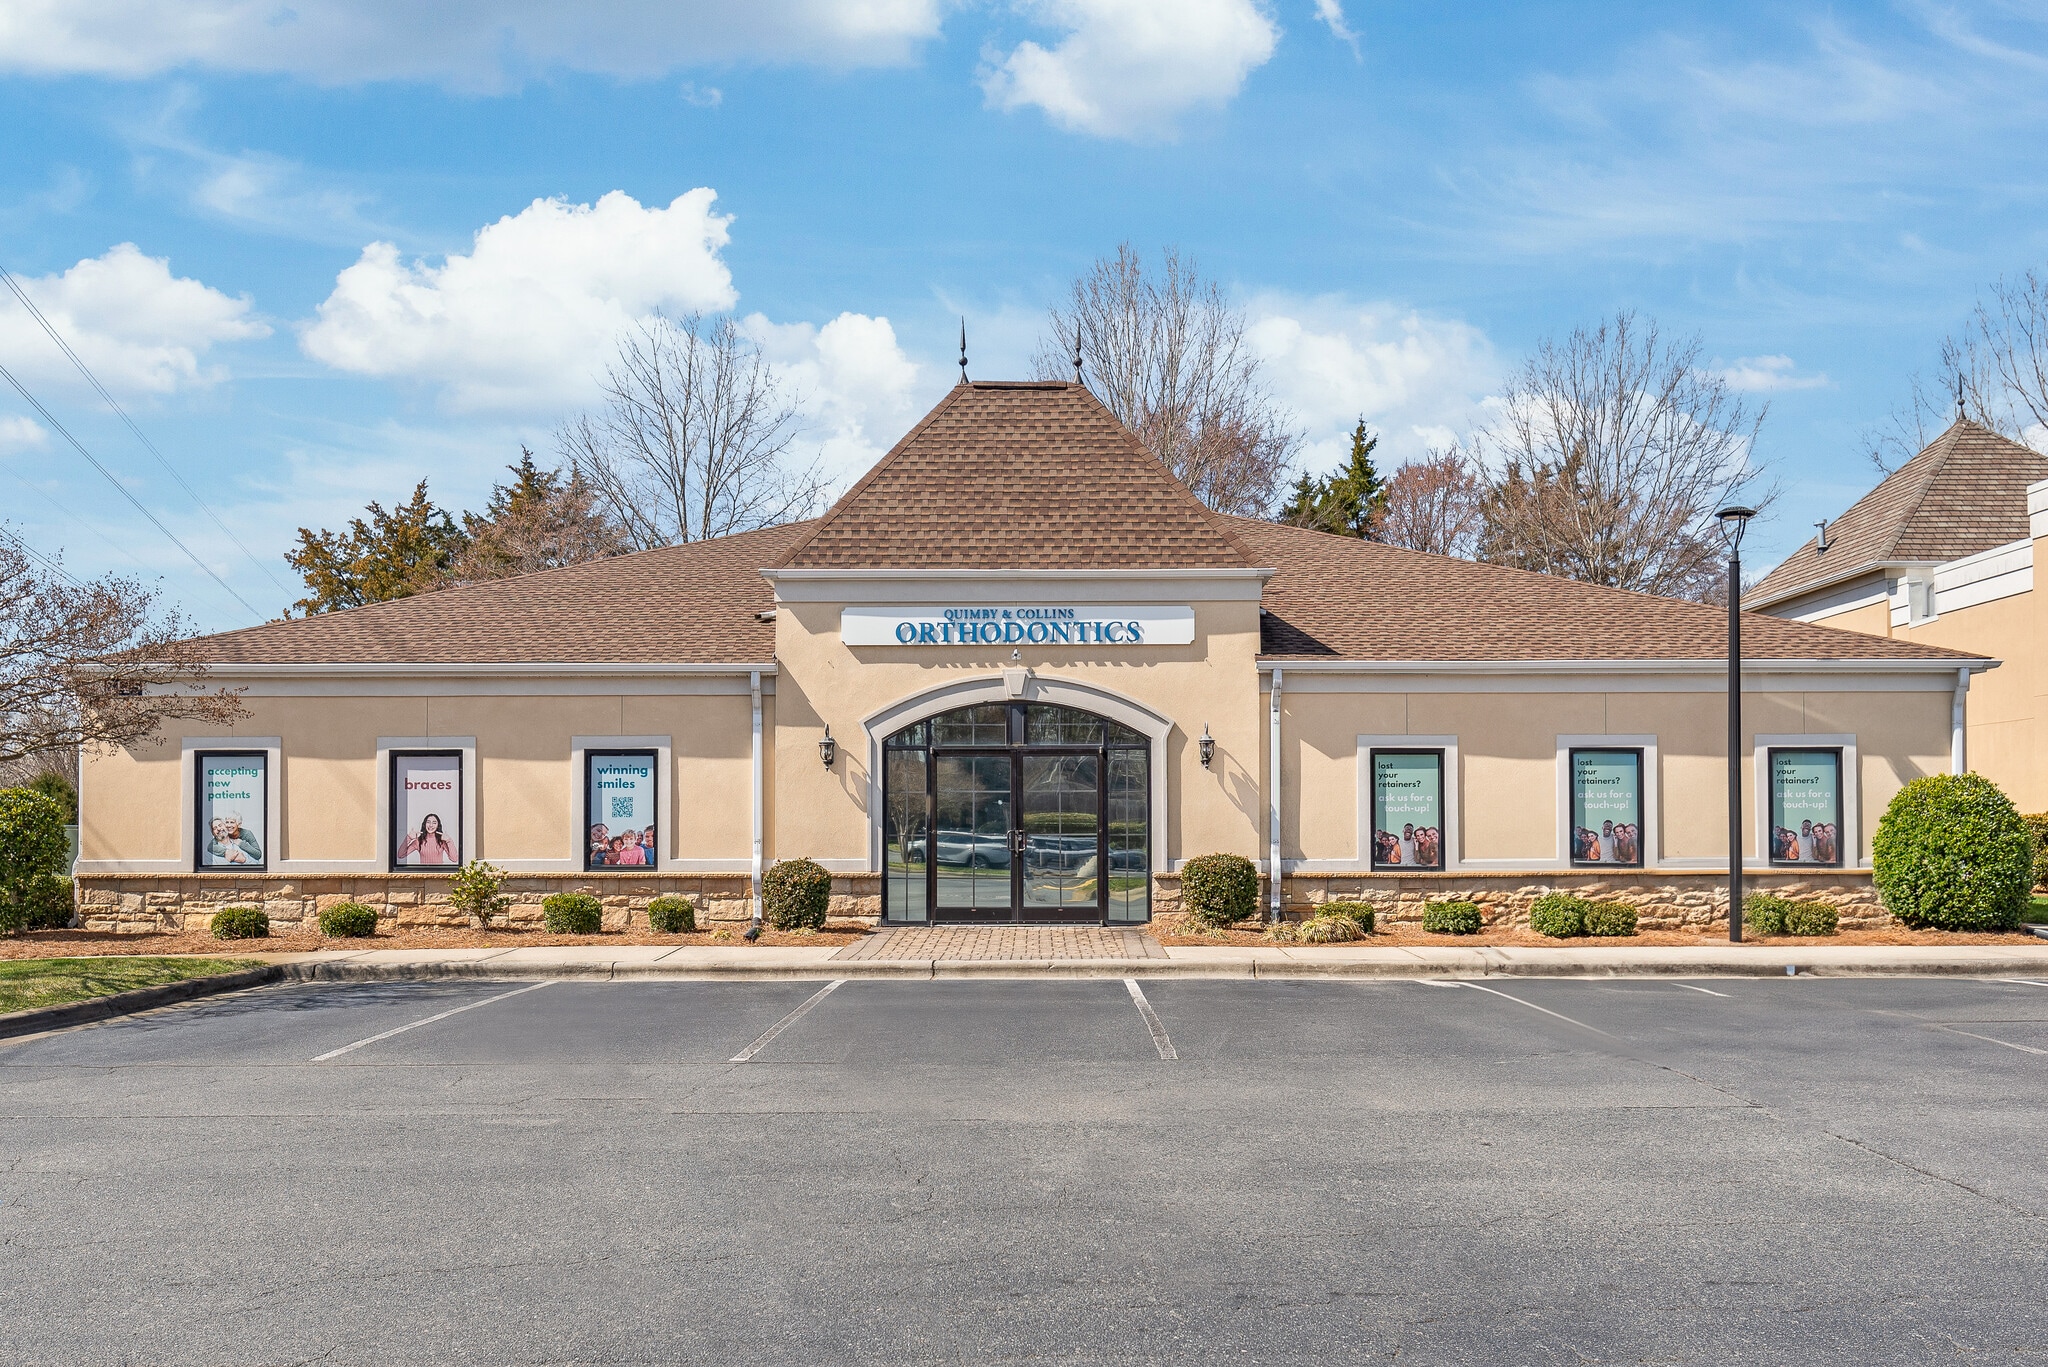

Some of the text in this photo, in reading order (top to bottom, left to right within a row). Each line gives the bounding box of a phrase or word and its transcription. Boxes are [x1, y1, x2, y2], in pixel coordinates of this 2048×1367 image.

[944, 608, 1075, 621] QUIMBY & COLLINS
[895, 621, 1140, 644] ORTHODONTICS
[208, 766, 258, 777] accepting
[597, 764, 648, 777] winning
[404, 778, 452, 790] braces
[597, 778, 636, 788] smiles
[208, 790, 250, 801] patients
[1378, 793, 1395, 801] ask
[1410, 793, 1424, 801] for
[1578, 790, 1594, 798] ask
[1609, 790, 1623, 798] for
[1777, 790, 1793, 798] ask
[1808, 789, 1822, 798] for
[1385, 804, 1430, 814] touch-up!
[1584, 800, 1628, 810] touch-up!
[1783, 800, 1828, 810] touch-up!
